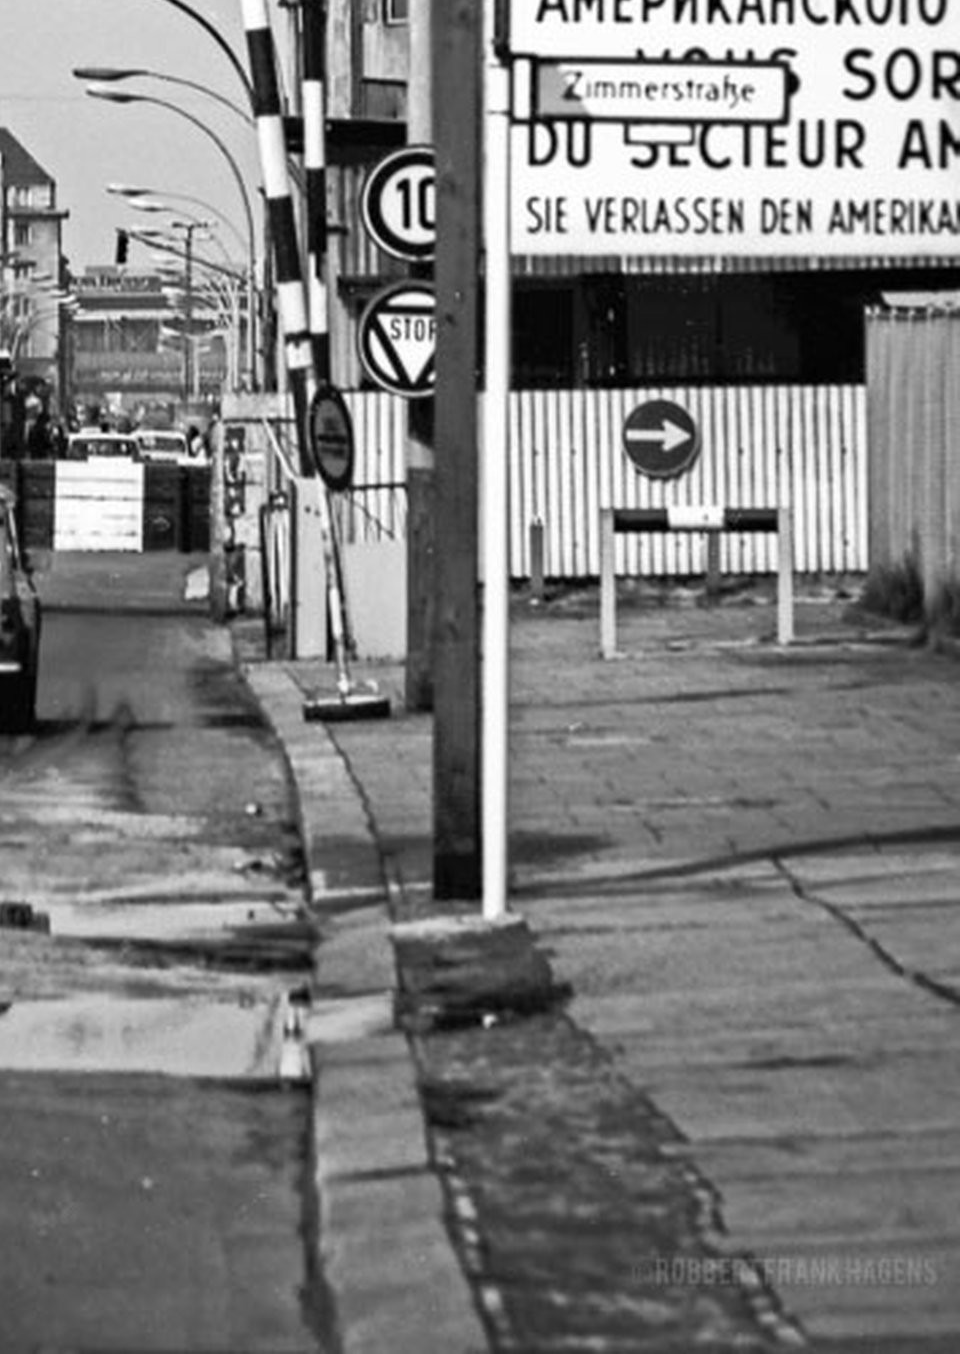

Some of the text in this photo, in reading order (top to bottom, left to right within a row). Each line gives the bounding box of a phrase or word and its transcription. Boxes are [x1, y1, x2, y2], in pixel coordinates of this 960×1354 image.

[560, 71, 756, 109] Zimmerstraße
[528, 123, 591, 168] DU
[396, 177, 435, 230] 10
[527, 197, 960, 236] SIE VERLASSEN DEN AMERIKA
